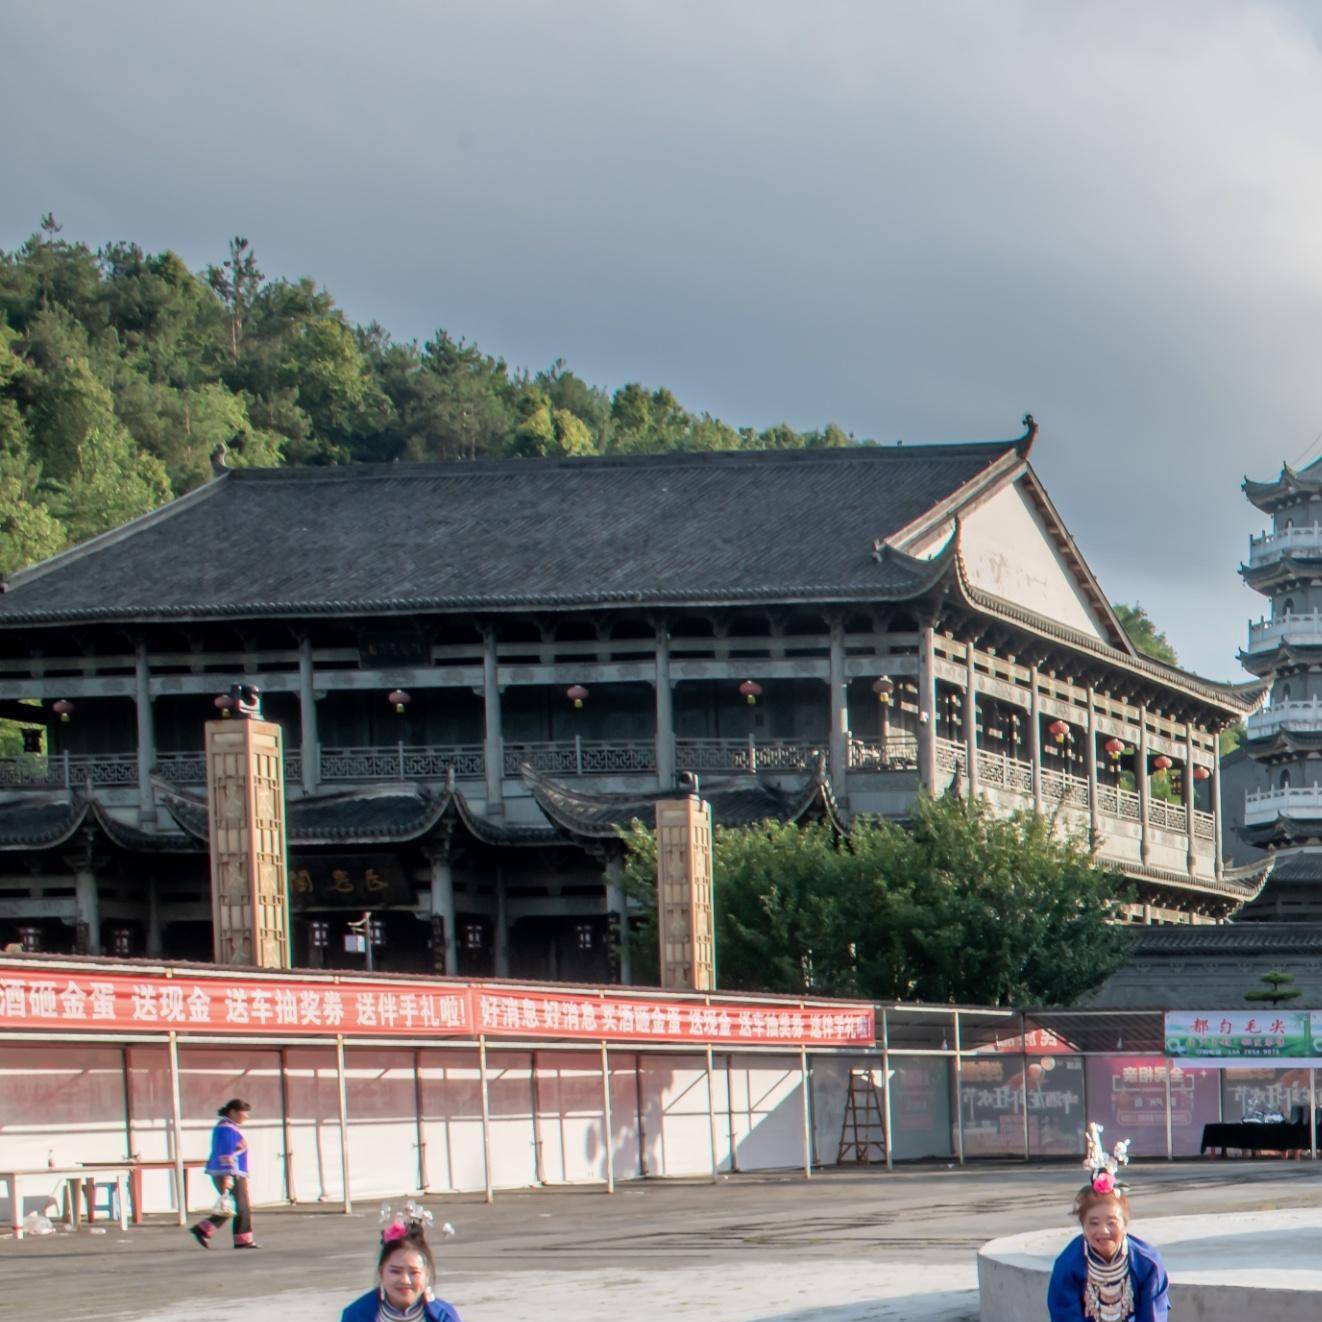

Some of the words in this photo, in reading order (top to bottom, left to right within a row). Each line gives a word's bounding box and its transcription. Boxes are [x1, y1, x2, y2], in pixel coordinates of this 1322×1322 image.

[131, 984, 212, 1023] 送现金
[481, 995, 539, 1028] 好消息
[543, 999, 598, 1031] 好消息
[1191, 1016, 1286, 1036] 都匀毛尖
